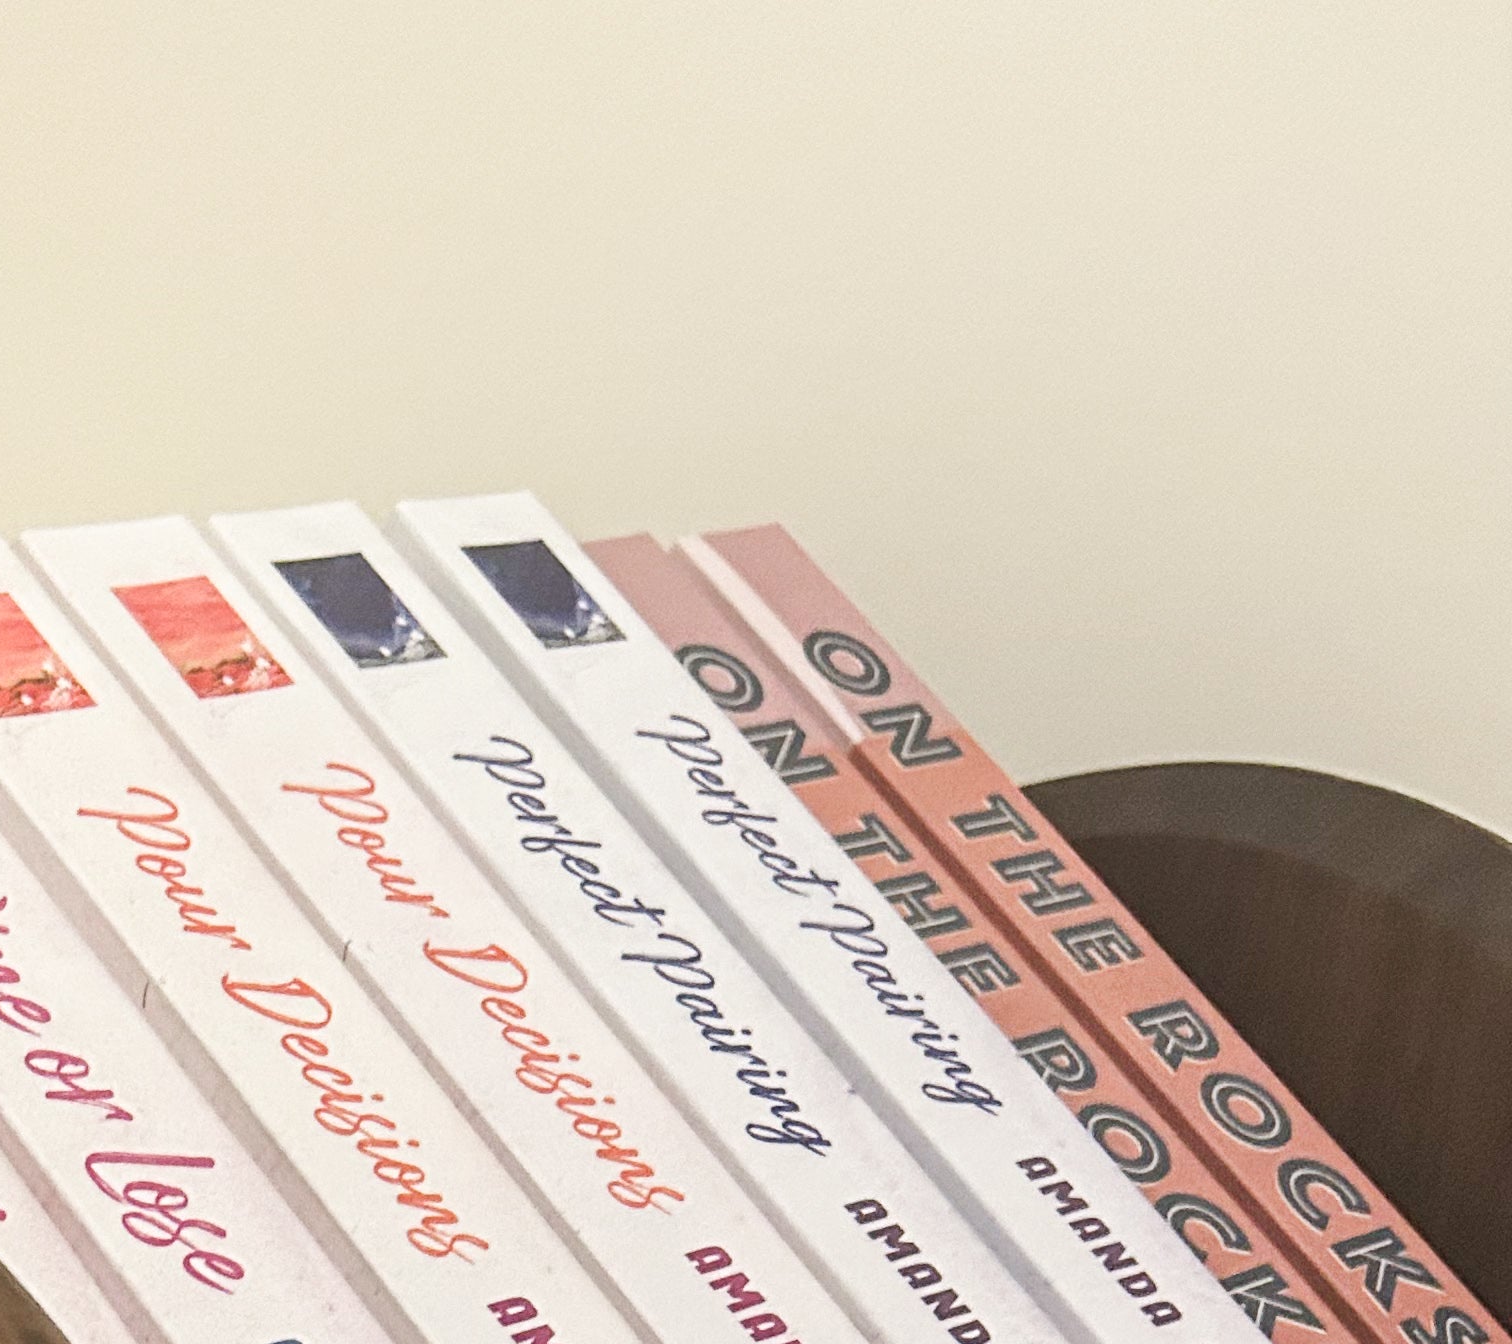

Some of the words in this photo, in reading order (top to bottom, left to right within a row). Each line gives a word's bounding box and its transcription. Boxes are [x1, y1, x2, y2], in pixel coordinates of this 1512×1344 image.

[281, 763, 450, 920] Pour
[423, 938, 685, 1216] Decisions
[452, 736, 665, 934] Perfect
[622, 934, 831, 1158] Pairing
[675, 644, 839, 786] ON
[833, 813, 1021, 998] THE
[803, 631, 963, 768] ON
[950, 793, 1141, 972] THE
[24, 1050, 134, 1123] or
[85, 1151, 246, 1297] Lose
[76, 786, 251, 952] Pour
[221, 972, 490, 1266] Decisions
[637, 715, 839, 905] Perfect
[800, 904, 1002, 1117] Pairing
[1016, 1156, 1183, 1328] AMANDA
